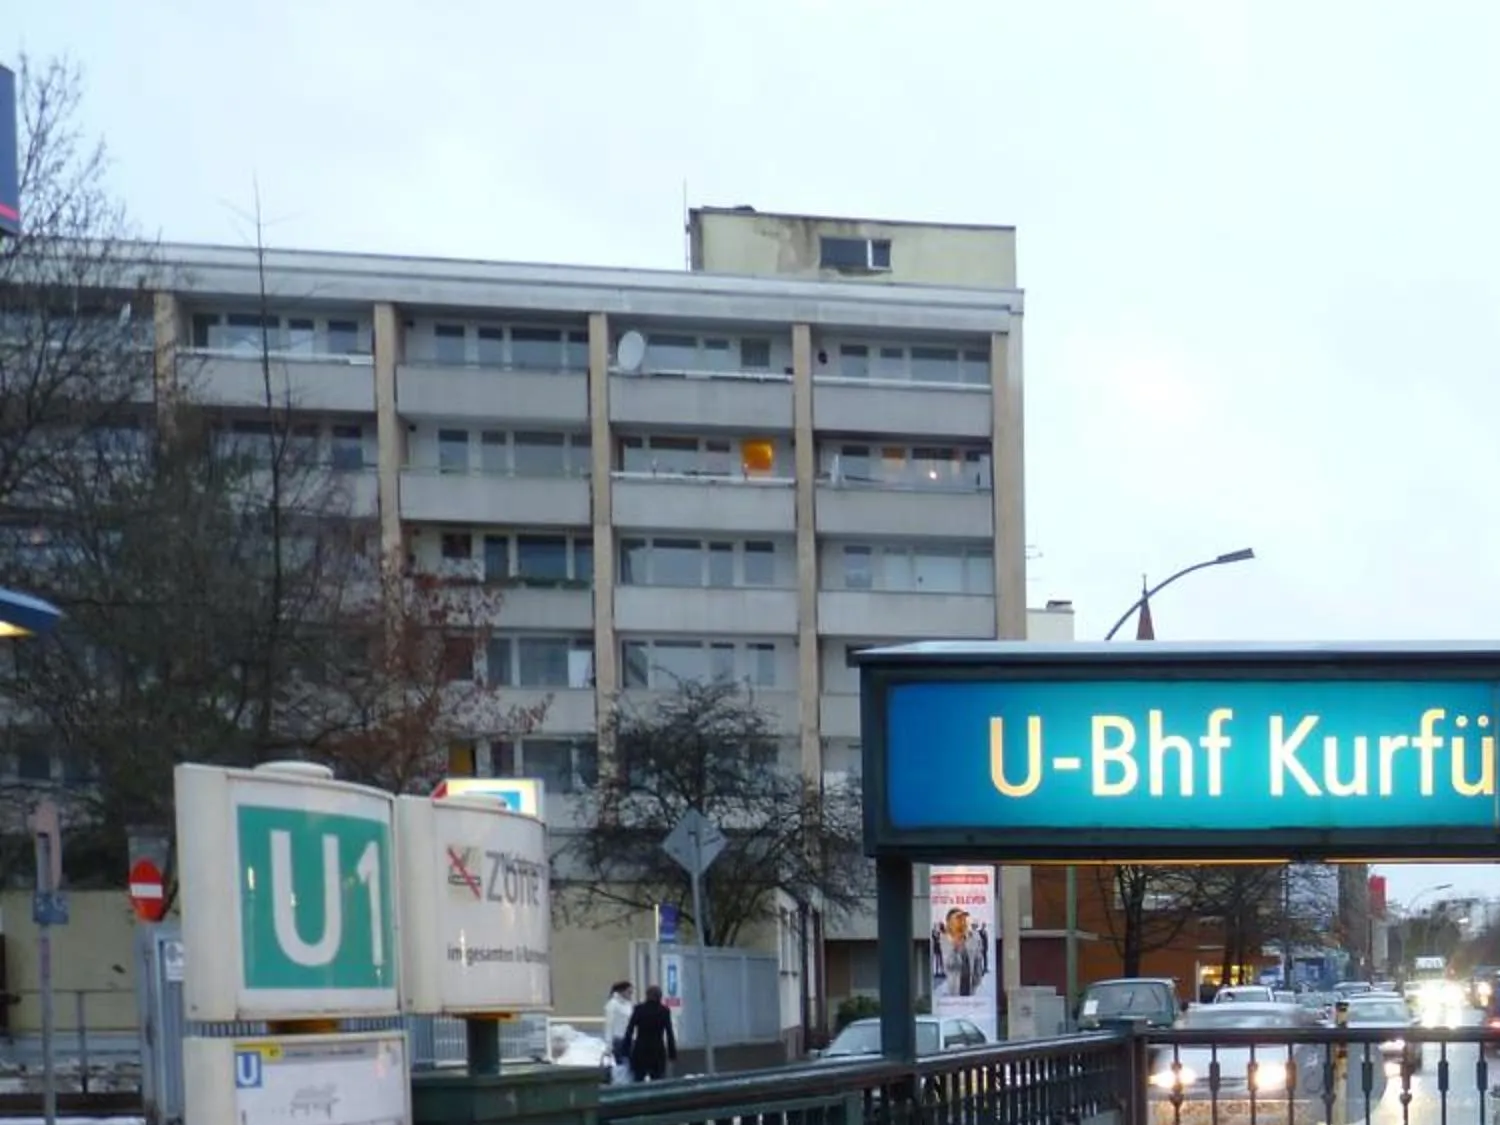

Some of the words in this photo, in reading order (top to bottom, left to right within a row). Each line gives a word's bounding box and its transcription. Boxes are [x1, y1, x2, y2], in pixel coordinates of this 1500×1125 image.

[988, 708, 1234, 799] U-Bhf
[270, 829, 383, 967] U1
[236, 1053, 258, 1086] U
